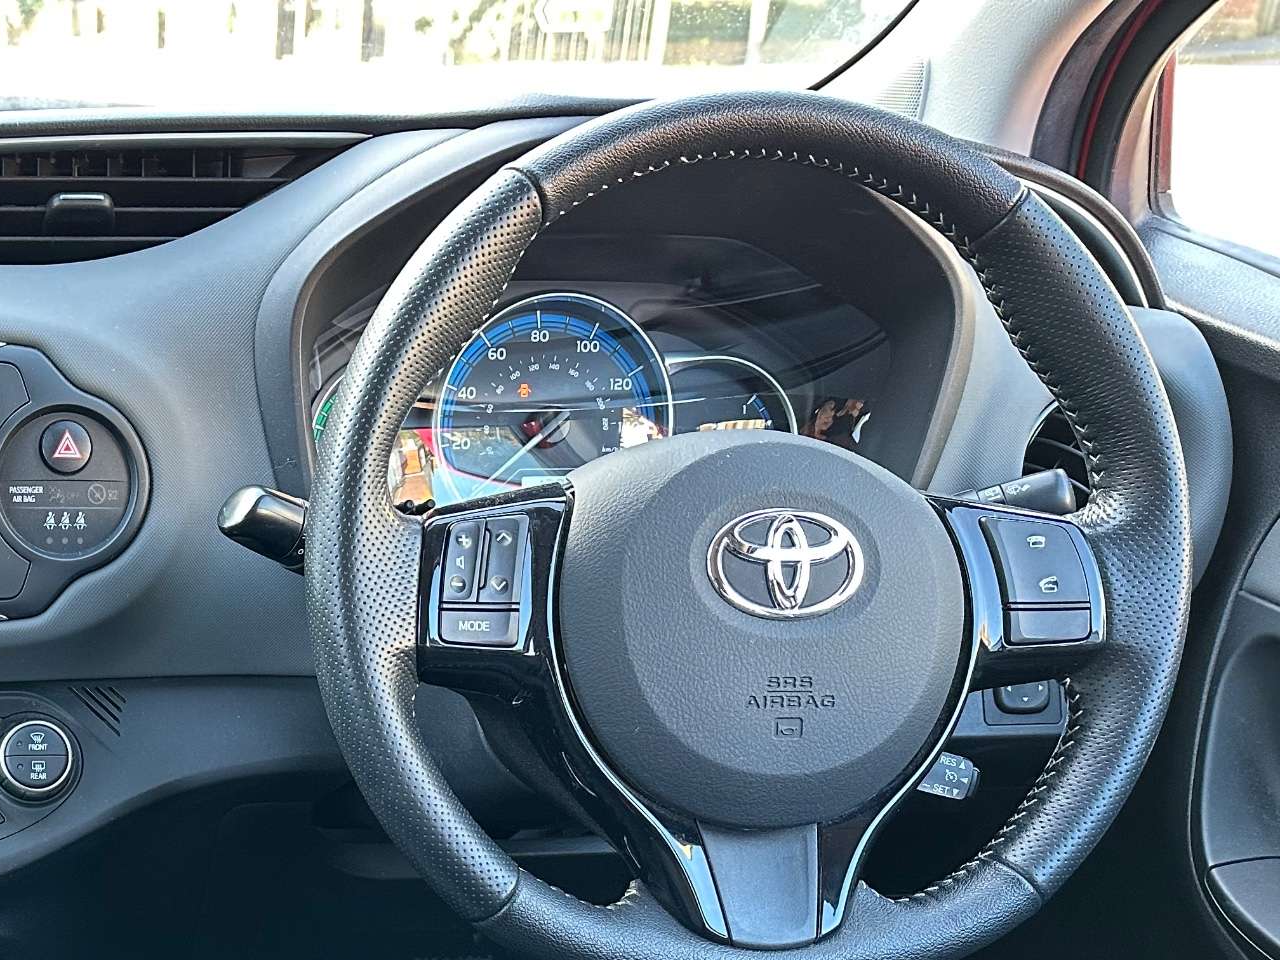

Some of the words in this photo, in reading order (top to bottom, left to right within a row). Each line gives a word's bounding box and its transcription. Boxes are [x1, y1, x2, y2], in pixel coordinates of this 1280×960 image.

[530, 330, 549, 343] 80
[576, 340, 599, 353] 100
[487, 348, 506, 360] 60
[528, 364, 539, 372] 120
[510, 370, 521, 380] 100
[609, 378, 632, 391] 120
[457, 386, 476, 399] 40
[452, 437, 471, 450] 20
[9, 486, 44, 494] PASSENGER
[12, 495, 22, 503] AIR
[23, 495, 36, 503] BAG
[458, 620, 490, 632] MODE
[767, 676, 814, 689] SRS
[746, 694, 836, 709] AIRBAG
[28, 743, 48, 752] FRONT
[939, 755, 957, 767] RES
[30, 771, 47, 780] REAR
[932, 783, 950, 795] SET
